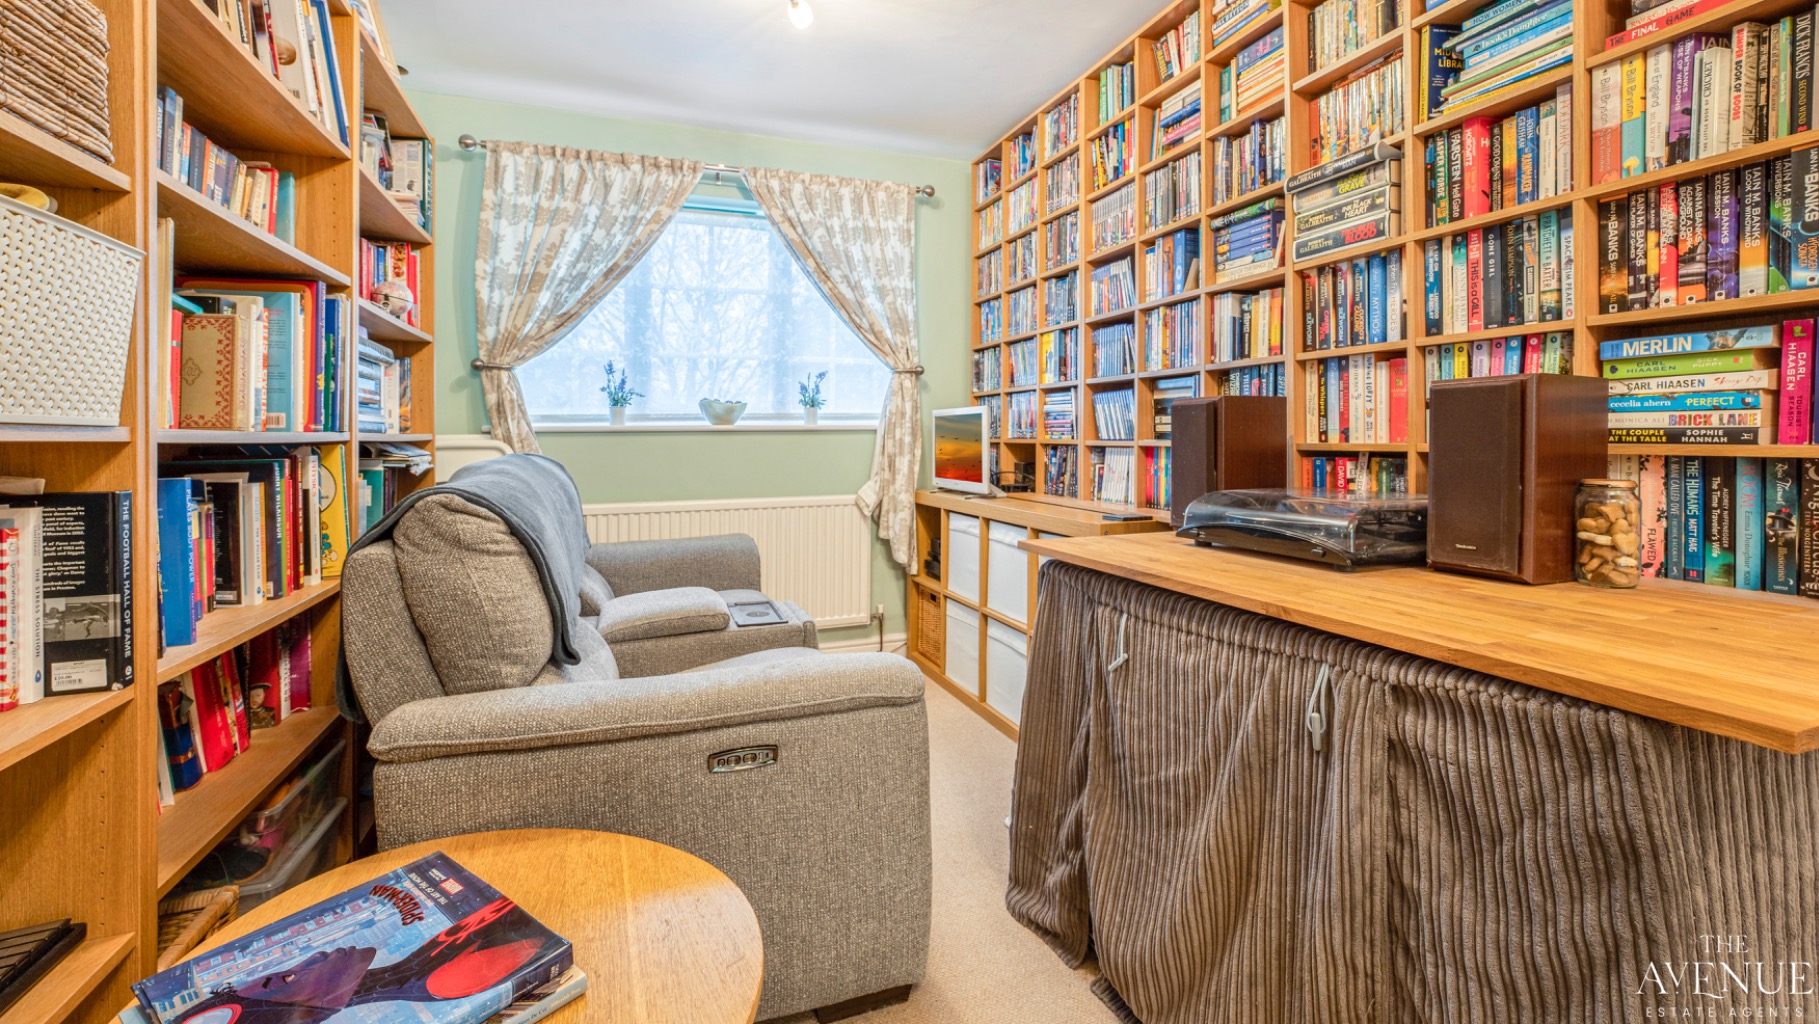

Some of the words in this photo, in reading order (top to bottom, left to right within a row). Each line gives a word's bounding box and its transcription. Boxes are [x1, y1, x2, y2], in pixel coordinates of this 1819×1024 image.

[1508, 13, 1547, 40] Daughter
[1609, 34, 1627, 47] THE
[1631, 22, 1659, 40] FINAL
[1665, 6, 1696, 26] GAME
[1796, 14, 1811, 37] DICK
[1735, 28, 1745, 59] BUMPER
[1795, 38, 1811, 80] FRANCIS
[1626, 67, 1637, 84] Bill
[1703, 61, 1713, 98] CRICKET
[1733, 59, 1743, 83] BOOK
[1600, 77, 1610, 91] Bill
[1733, 83, 1741, 93] OF
[1798, 79, 1807, 105] SECOND
[1600, 93, 1610, 126] Bryson
[1626, 84, 1637, 118] Bryson
[1557, 90, 1568, 152] POLDARK
[1798, 105, 1807, 125] WIND
[1517, 116, 1526, 149] GRISHAM
[1526, 118, 1534, 139] JOHN
[1436, 136, 1445, 166] JASPER
[1451, 133, 1462, 182] FAIRSTEIN
[1465, 129, 1473, 167] HOROWITZ
[1521, 153, 1533, 193] RAINMAKER
[1744, 169, 1752, 192] LOOK
[1753, 167, 1762, 191] IAIN
[1783, 158, 1792, 181] IAIN
[1338, 179, 1365, 194] GRAVE
[1437, 167, 1446, 198] FFORDE
[1452, 183, 1461, 199] Hell
[1695, 183, 1703, 201] IAIN
[1722, 173, 1730, 195] IAIN
[1452, 199, 1461, 218] Gate
[1636, 194, 1645, 215] IAIN
[1744, 193, 1752, 204] TO
[1344, 206, 1367, 218] HEART
[1782, 198, 1792, 238] BANKS
[1345, 227, 1377, 245] BLOOD
[1507, 225, 1515, 245] JOHN
[1721, 208, 1730, 245] BANKS
[1744, 204, 1752, 248] WINDWARD
[1751, 207, 1761, 247] BANKS
[1487, 233, 1495, 256] GONE
[1608, 221, 1619, 261] BANKS
[1636, 229, 1644, 267] BANKS
[1389, 253, 1398, 281] Stephen
[1507, 246, 1515, 277] SIMPSON
[1798, 243, 1807, 268] SONATA
[1459, 262, 1467, 294] JOANNE
[1487, 258, 1495, 278] GIRL
[1389, 282, 1397, 293] Fry
[1471, 282, 1478, 290] is
[1371, 296, 1379, 334] MYTHOS
[1459, 295, 1467, 327] HARRIS
[1471, 298, 1479, 318] CALL
[1622, 335, 1693, 357] MERLIN
[1626, 364, 1677, 374] HIAASEN
[1636, 359, 1666, 368] CARL
[1692, 361, 1723, 369] PUPPY
[1786, 342, 1797, 391] HIAASEN
[1797, 351, 1806, 381] CARL
[1627, 380, 1653, 392] CARL
[1656, 378, 1706, 390] HIAASEN
[1609, 399, 1641, 408] cecelia
[1643, 398, 1672, 407] ahern
[1684, 395, 1735, 407] PERFECT
[1787, 396, 1795, 427] SEASON
[1795, 395, 1803, 427] TOURIST
[1612, 416, 1649, 424] MONICA
[1668, 413, 1713, 427] BRICK
[1718, 412, 1758, 426] LANE
[1337, 465, 1345, 488] DAVID
[1687, 460, 1699, 477] THE
[1712, 476, 1720, 490] The
[1740, 464, 1758, 508] ROOM
[1686, 479, 1699, 516] HUMANS
[1712, 490, 1720, 508] Time
[121, 499, 131, 521] THE
[1744, 510, 1753, 531] Emma
[1688, 517, 1698, 537] MATT
[1712, 508, 1720, 541] Traveler's
[1722, 510, 1730, 548] NIFFENEGGER
[122, 523, 131, 578] FOOTBALL
[1647, 528, 1657, 562] FLAWED
[1688, 537, 1698, 553] HAIG
[1712, 541, 1720, 558] Wife
[1742, 533, 1753, 568] Donoghue
[123, 580, 131, 607] HALL
[123, 610, 131, 626] OF
[369, 884, 425, 927] SPIDER-MAN
